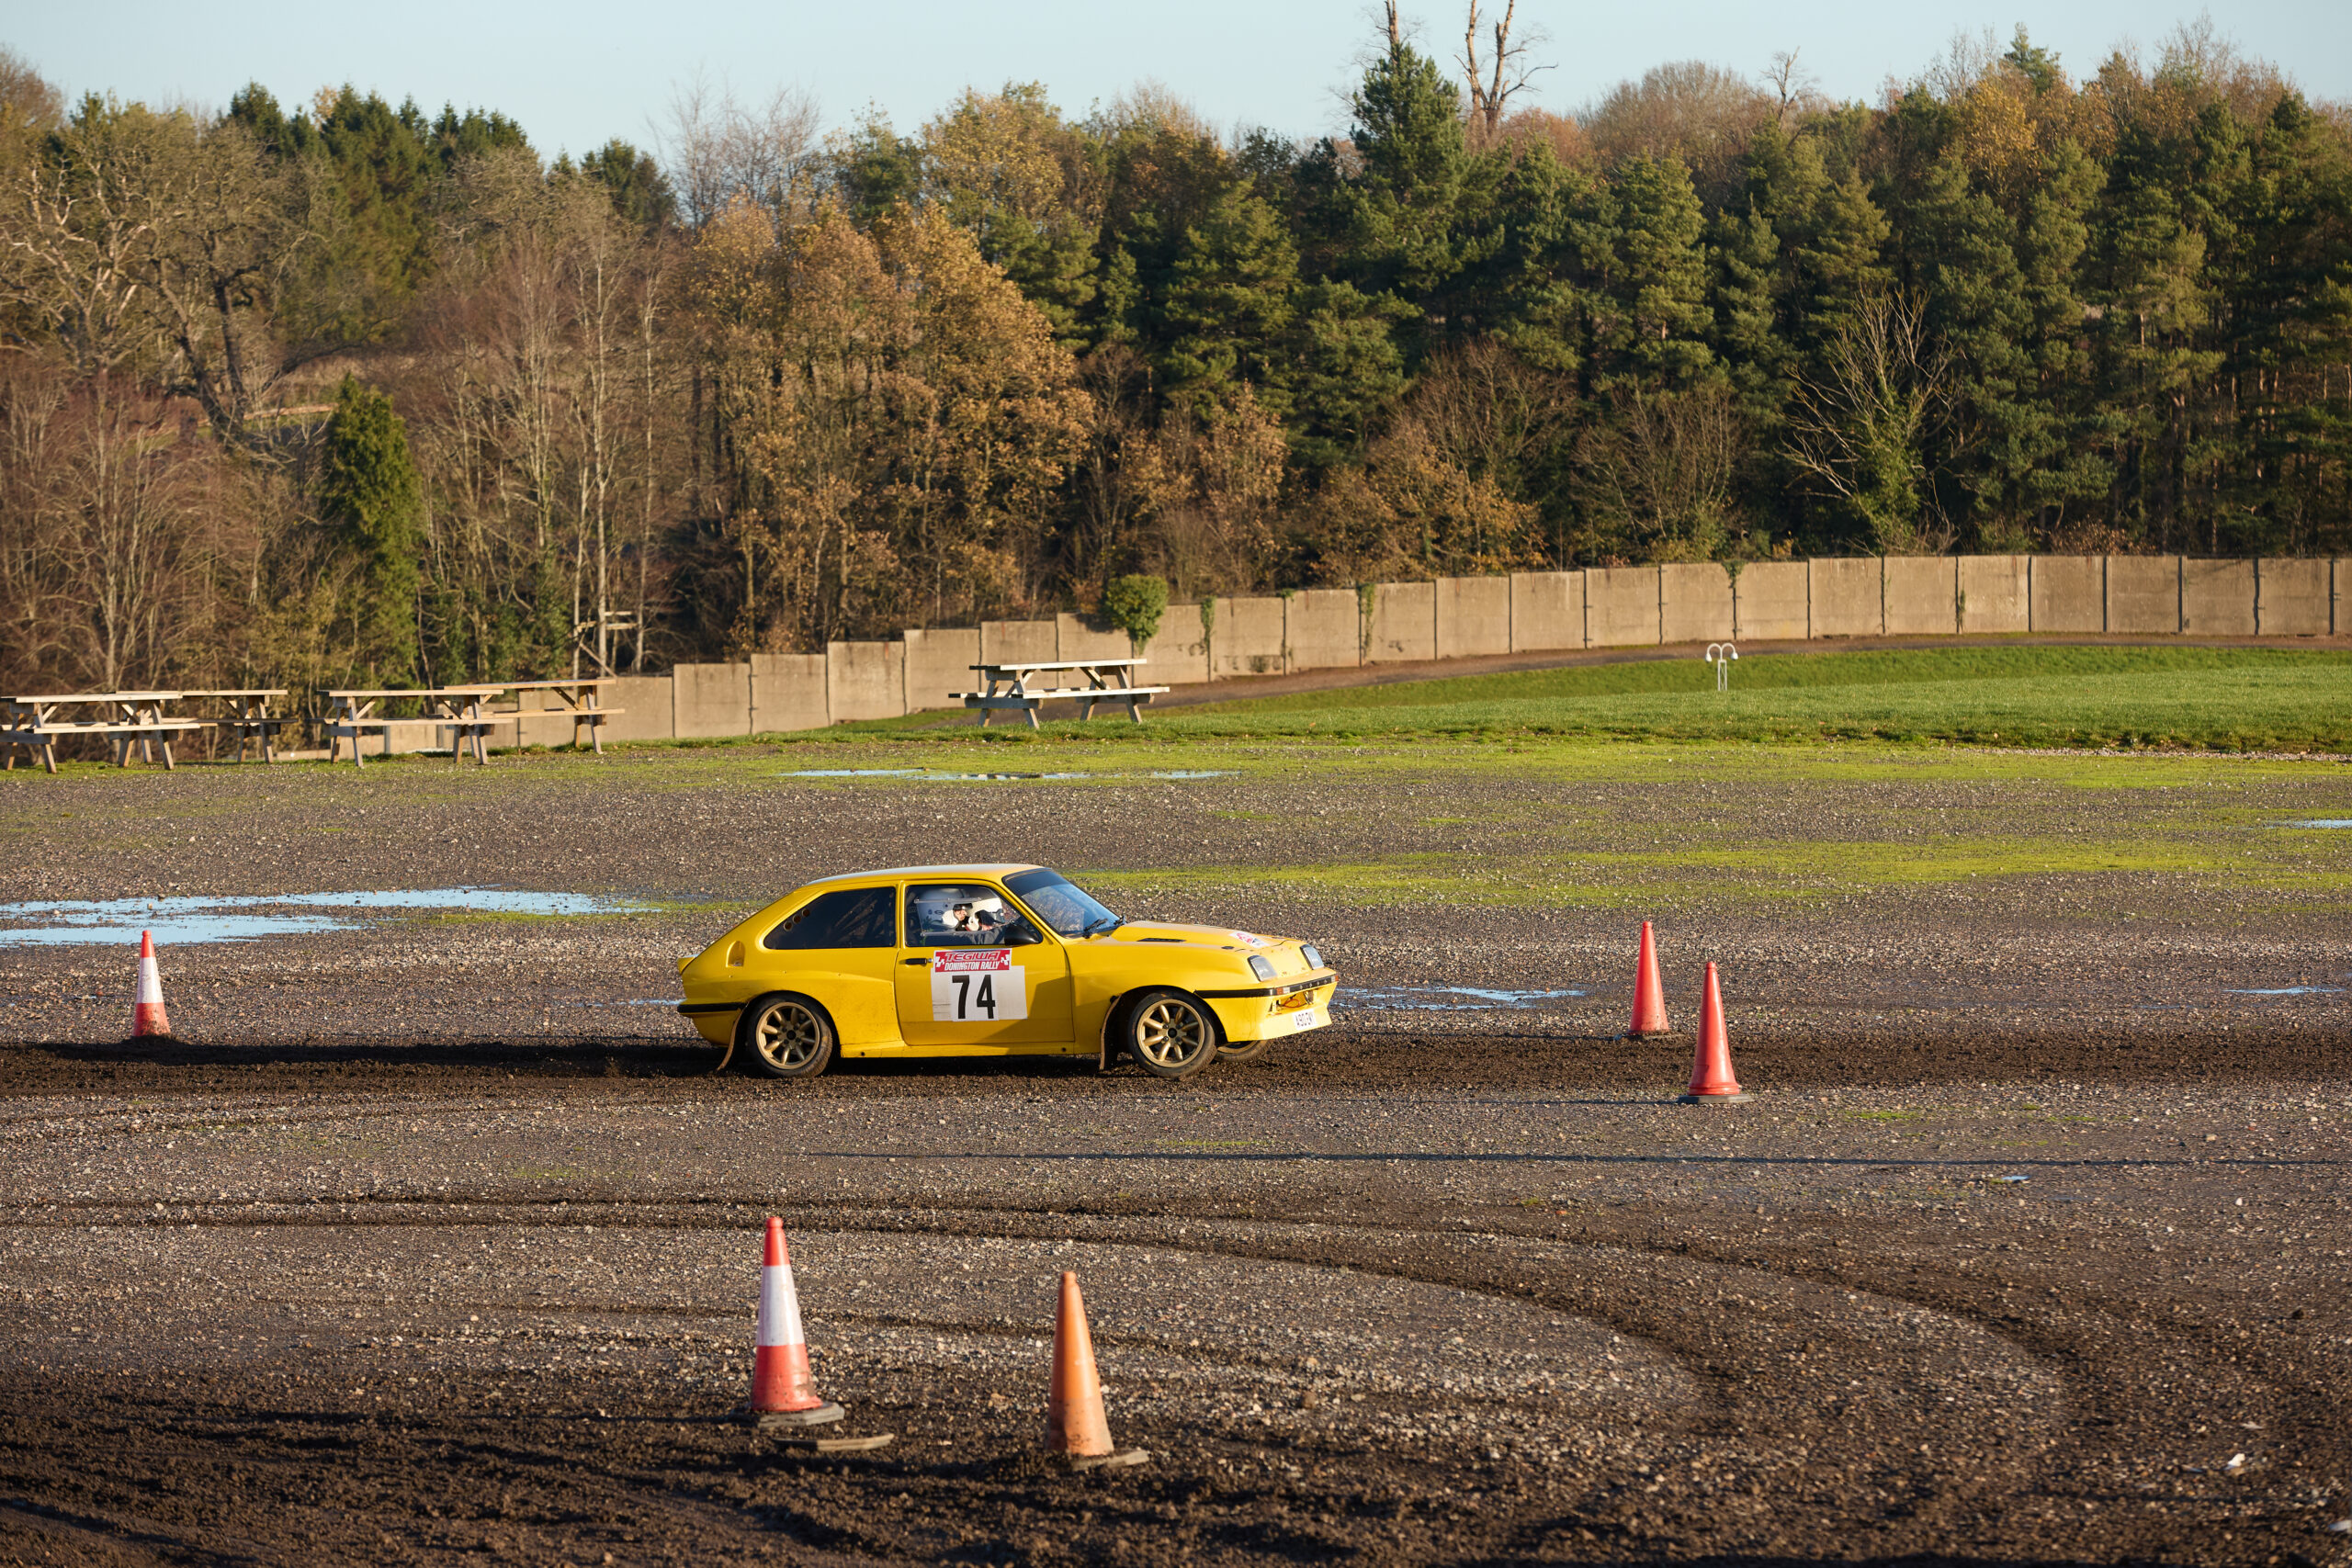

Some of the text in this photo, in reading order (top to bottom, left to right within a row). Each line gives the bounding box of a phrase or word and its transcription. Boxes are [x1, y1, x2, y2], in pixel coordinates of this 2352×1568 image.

[944, 950, 1001, 962] TEGIWA
[944, 961, 1001, 971] DONINGTON RALLY
[952, 975, 996, 1019] 74
